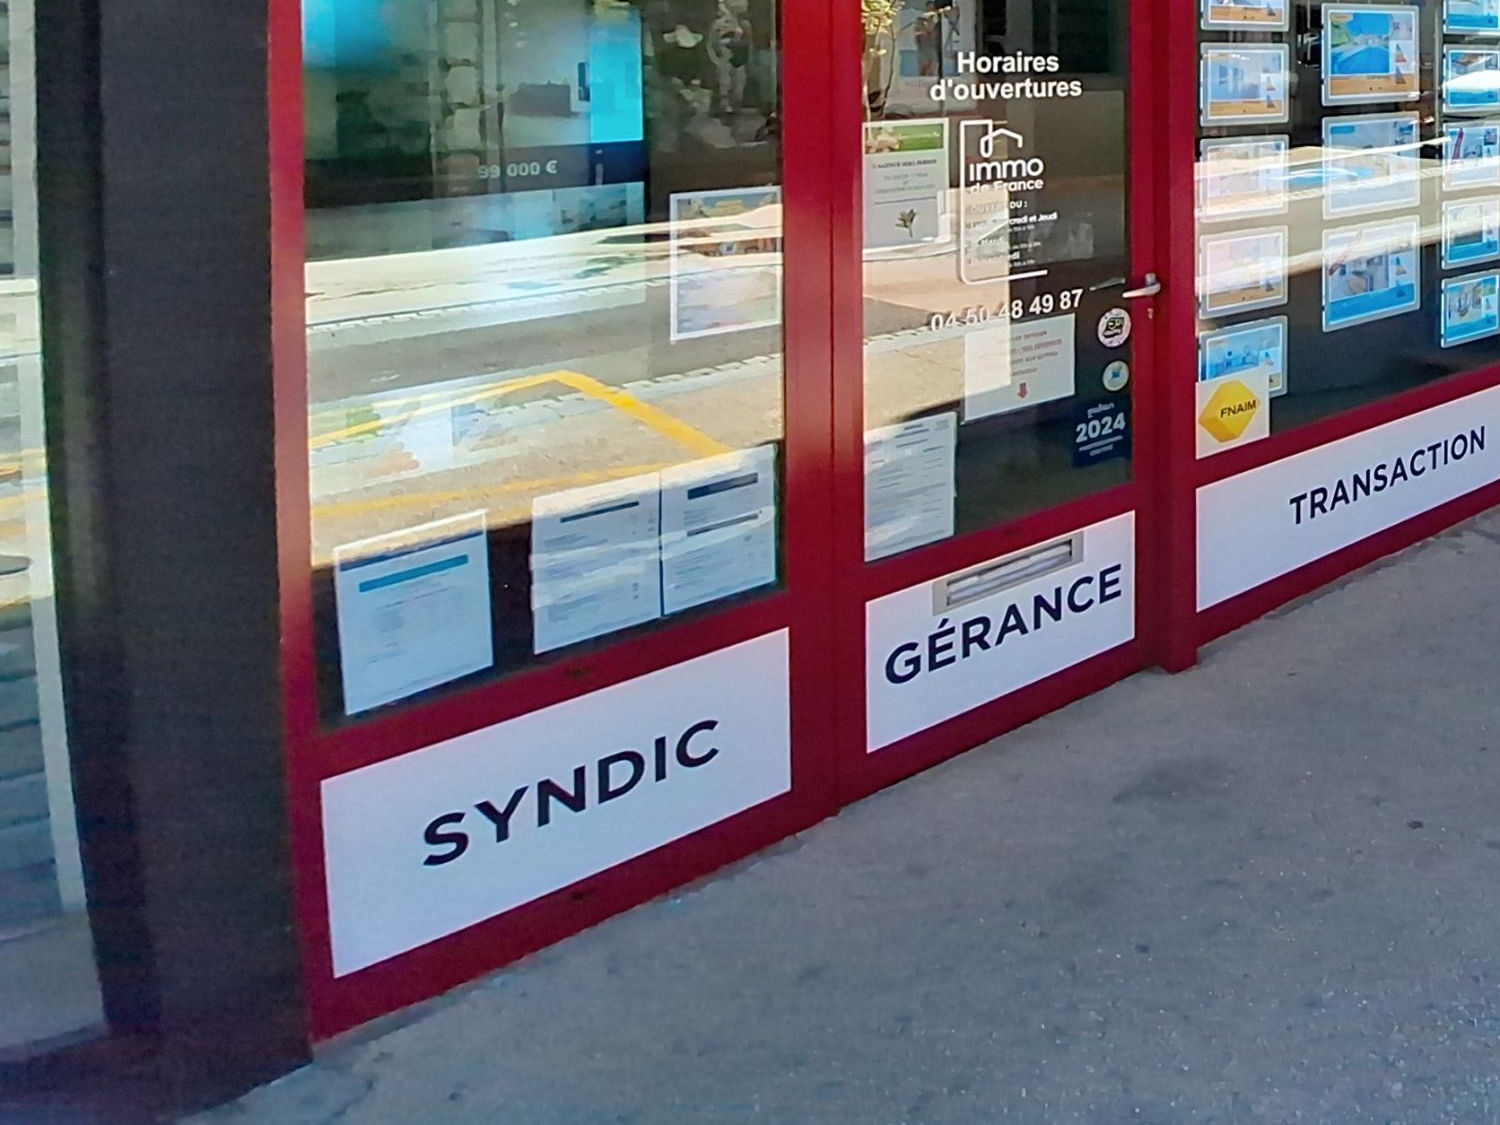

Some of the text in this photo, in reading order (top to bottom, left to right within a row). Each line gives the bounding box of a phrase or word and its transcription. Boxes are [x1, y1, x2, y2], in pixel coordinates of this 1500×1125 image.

[957, 51, 1060, 74] Horaires
[930, 79, 1083, 102] d'ouvertures
[506, 162, 541, 178] 000
[545, 160, 559, 174] €
[969, 158, 1045, 182] immo
[993, 178, 1045, 194] France
[931, 288, 1084, 333] 04 50 48 49 87
[1220, 400, 1257, 419] FNAIM
[1075, 412, 1126, 444] 2024
[1289, 426, 1486, 525] TRANSACTION
[885, 563, 1122, 685] GÉRANCE
[423, 720, 720, 866] SYNDIC
